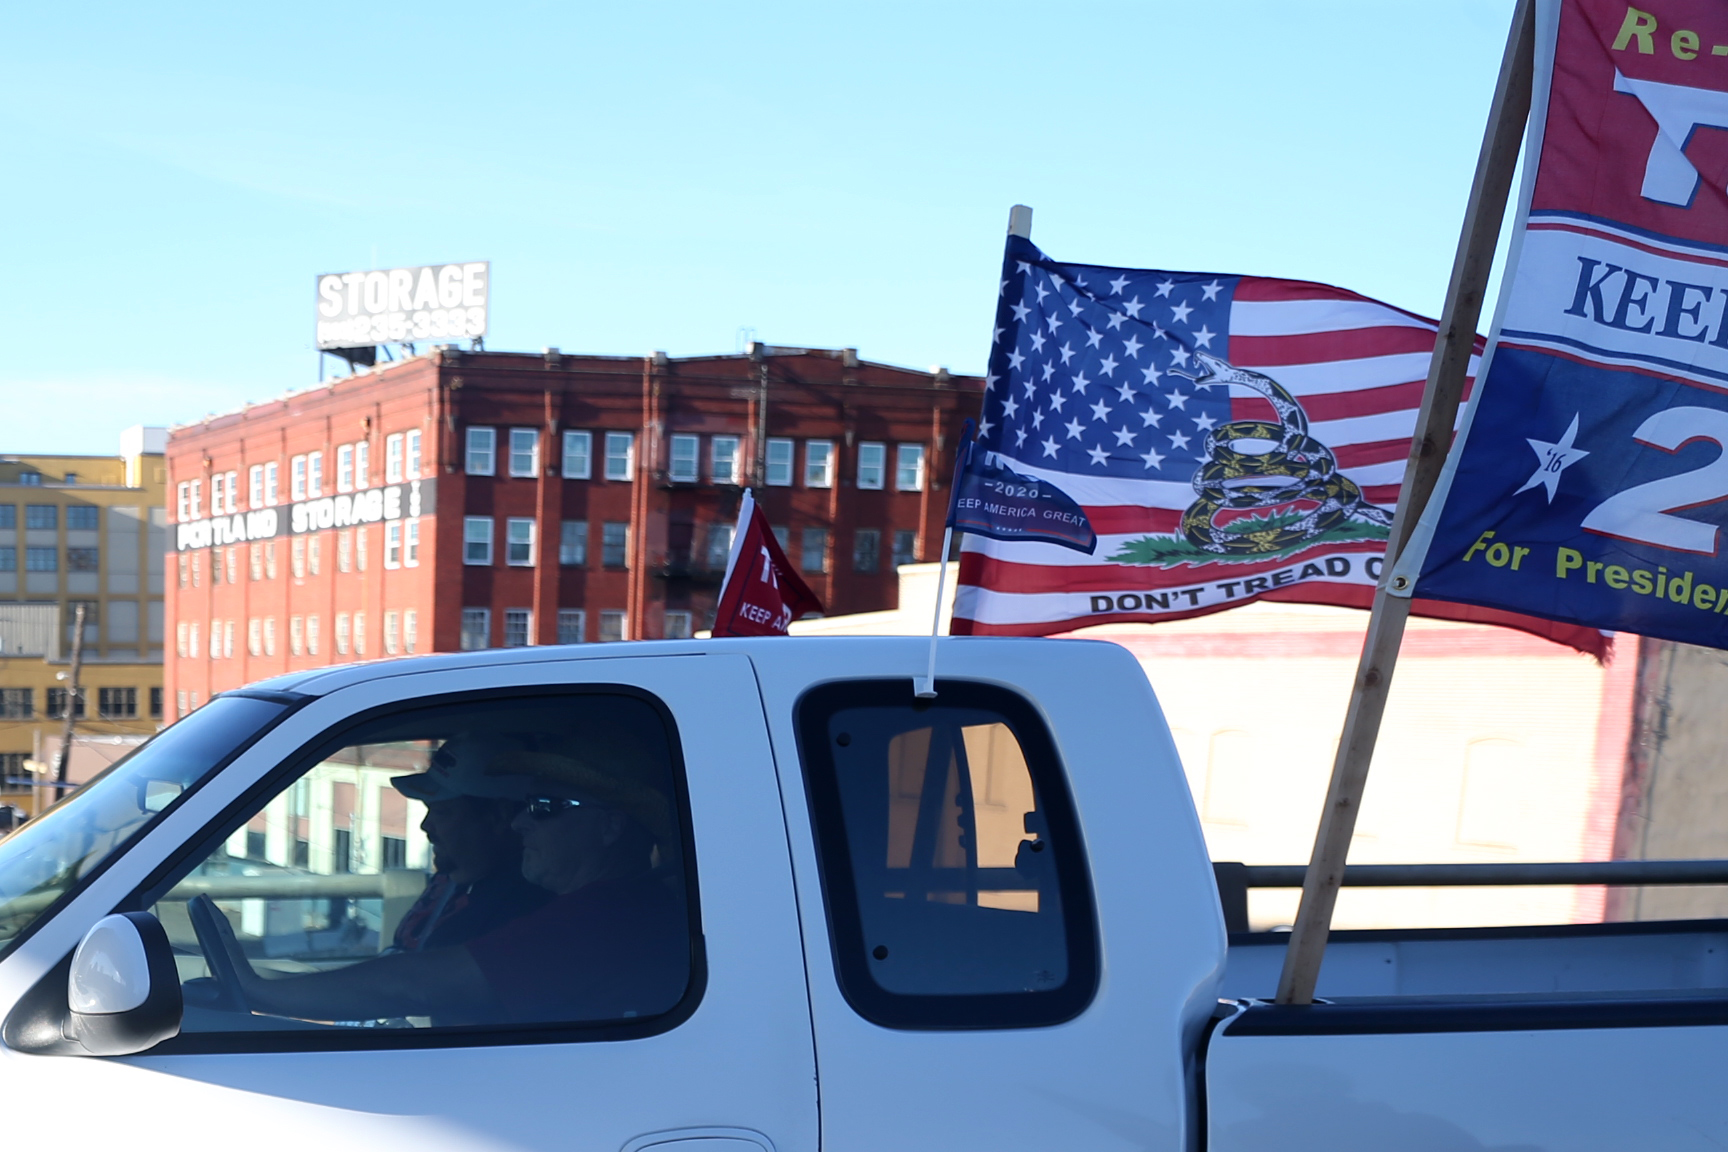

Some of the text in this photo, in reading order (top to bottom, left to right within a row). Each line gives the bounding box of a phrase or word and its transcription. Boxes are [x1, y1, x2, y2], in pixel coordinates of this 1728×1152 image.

[319, 263, 486, 317] STORAGE
[177, 509, 277, 551] PORTLAND
[292, 486, 401, 533] STORAGE
[957, 498, 1086, 527] EEP AMERICA GREAT
[1462, 530, 1530, 571] For
[1090, 588, 1204, 613] DON'T
[1217, 557, 1351, 599] TREAD
[739, 602, 772, 625] KEEP
